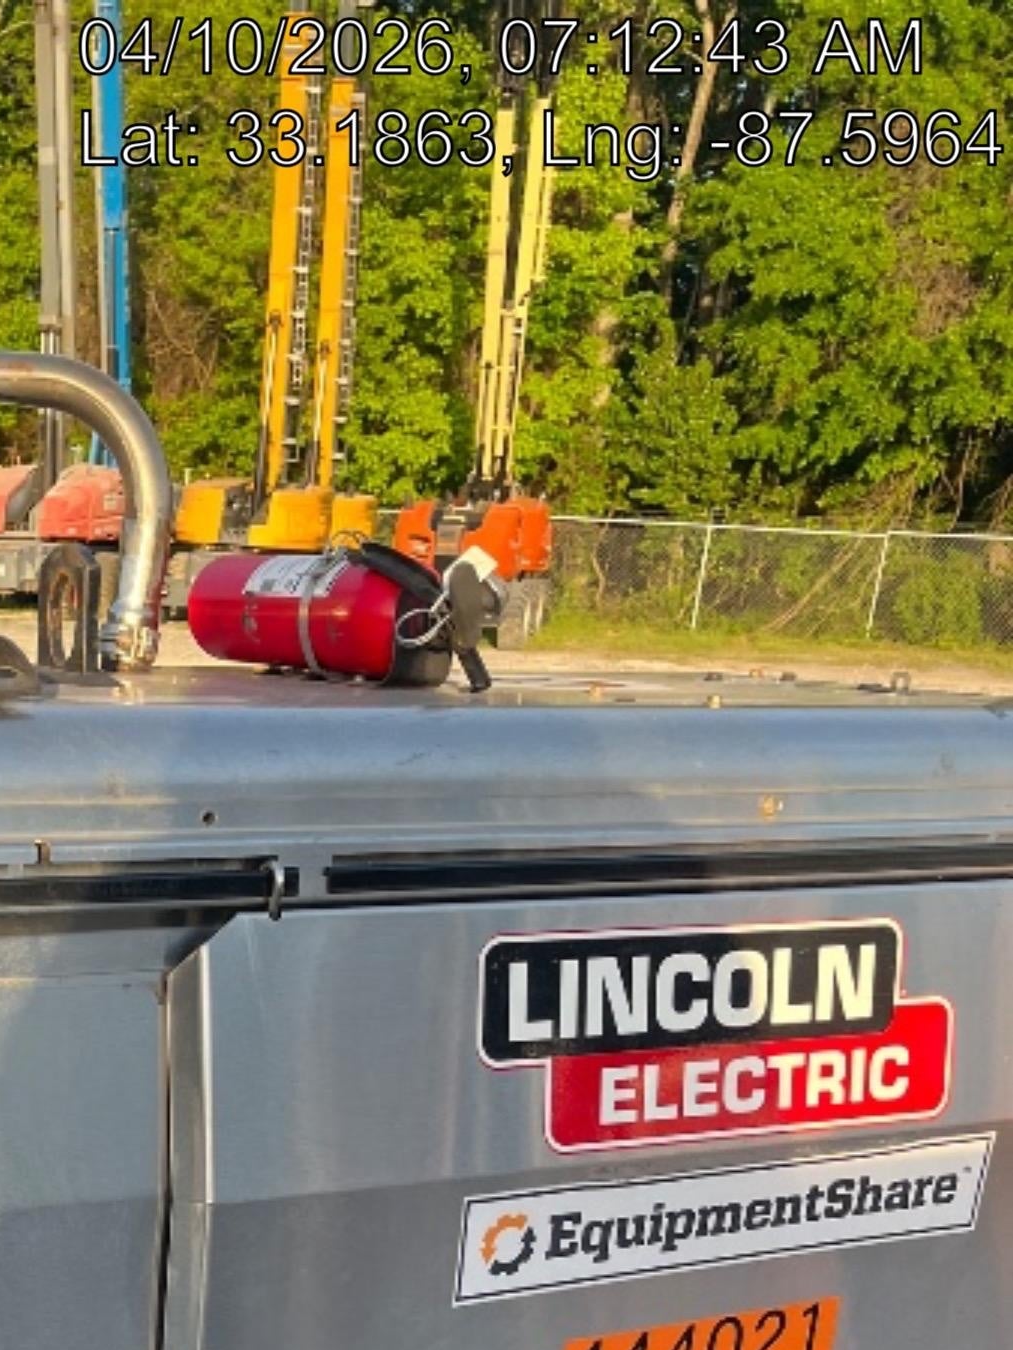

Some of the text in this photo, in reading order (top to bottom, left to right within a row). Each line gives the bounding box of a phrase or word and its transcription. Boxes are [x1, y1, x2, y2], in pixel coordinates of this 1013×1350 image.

[507, 943, 878, 1043] LINCOLN
[598, 1046, 910, 1127] ELECTRIC
[544, 1171, 958, 1262] EquipmentShare
